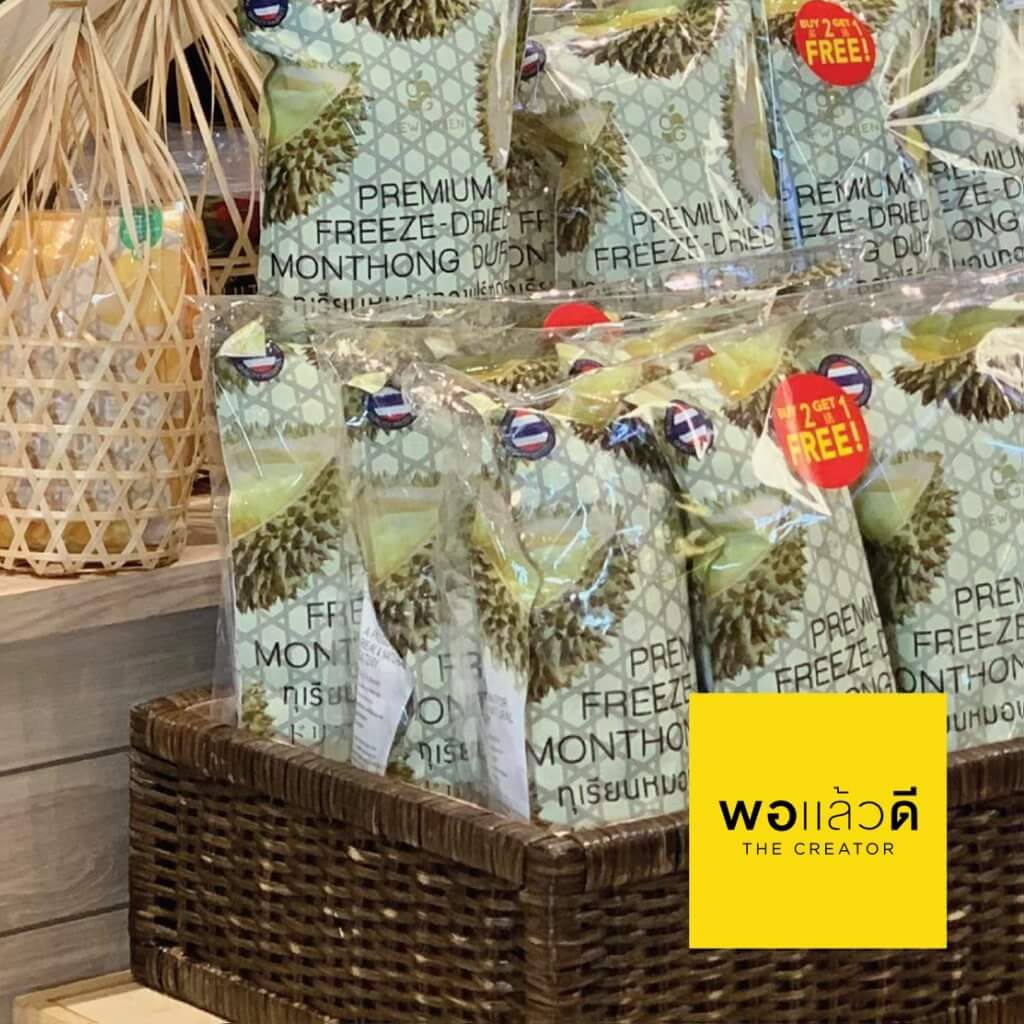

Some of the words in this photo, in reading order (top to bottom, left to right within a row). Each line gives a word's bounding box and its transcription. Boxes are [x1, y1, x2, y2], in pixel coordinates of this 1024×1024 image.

[822, 18, 835, 37] 2
[805, 38, 871, 65] FREE!
[358, 176, 493, 211] PREMIUM
[630, 197, 745, 236] PREMIUM
[270, 248, 461, 281] MONTHONG
[594, 225, 776, 272] FREEZE-DRIED
[800, 402, 816, 429] 2
[813, 396, 836, 413] GET
[838, 395, 852, 420] 1
[786, 421, 864, 466] FREE!
